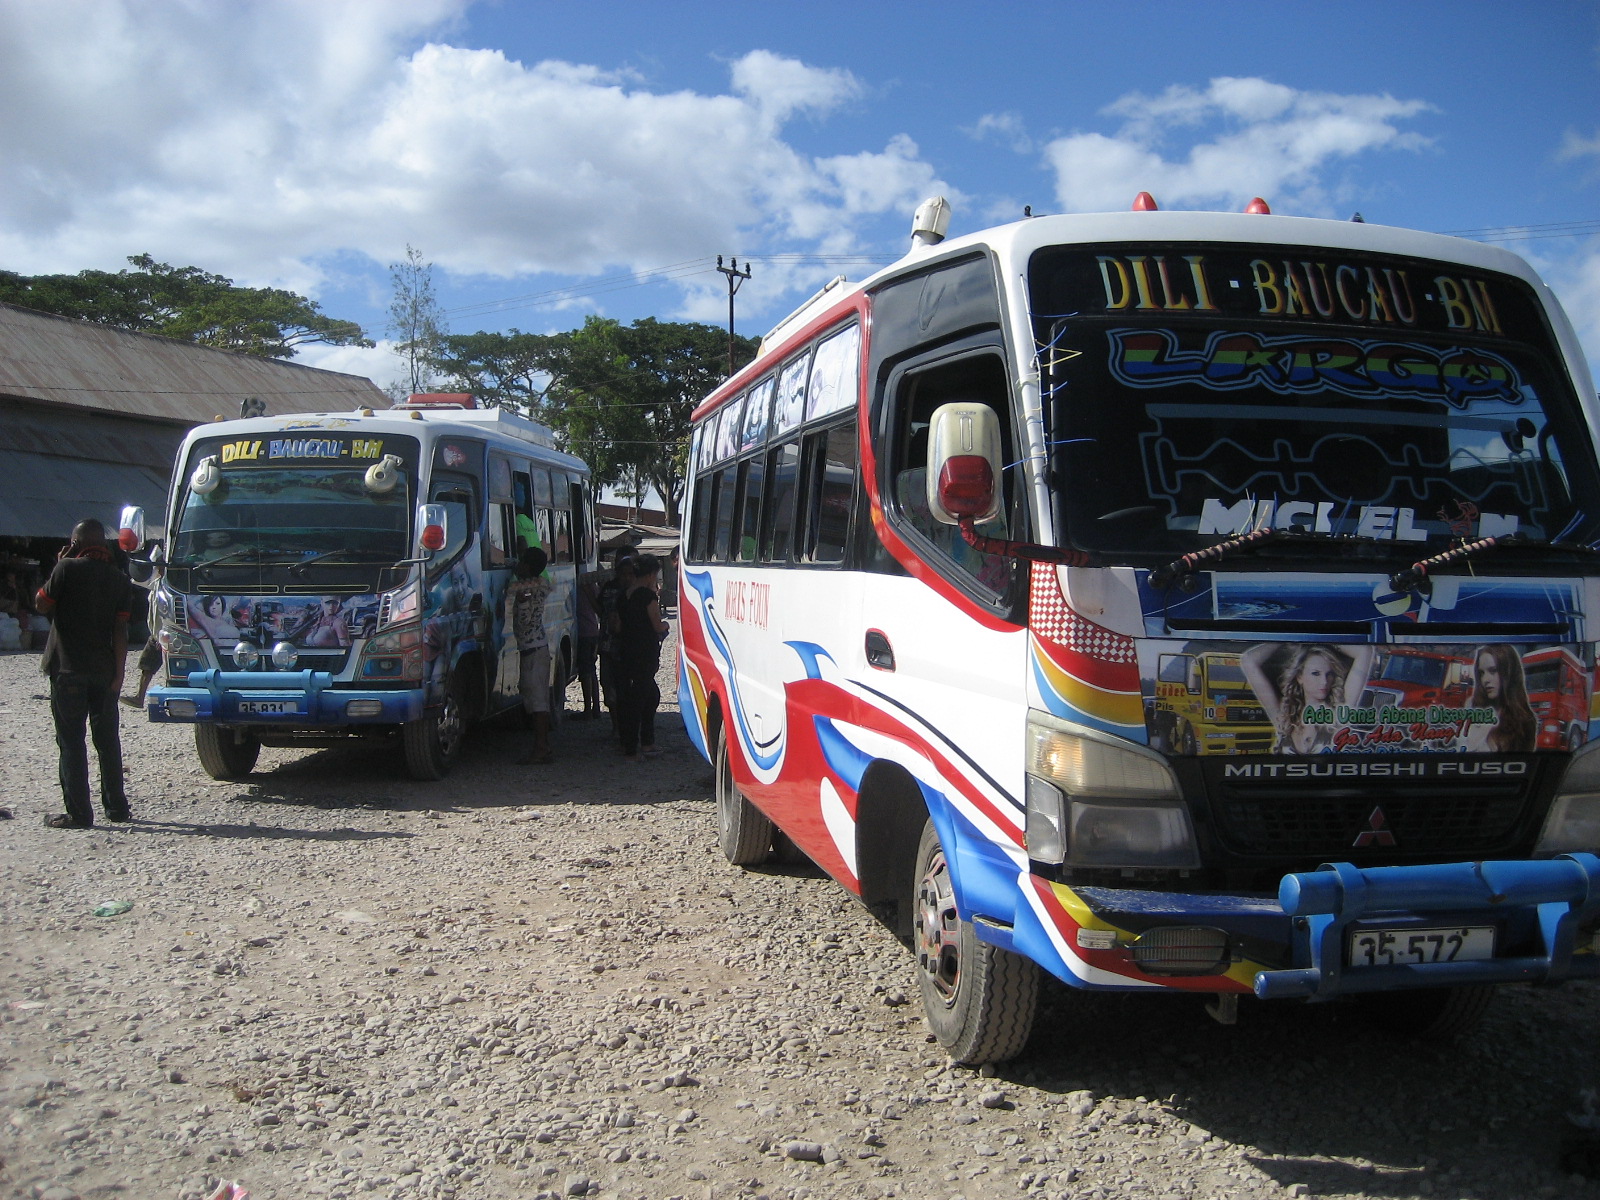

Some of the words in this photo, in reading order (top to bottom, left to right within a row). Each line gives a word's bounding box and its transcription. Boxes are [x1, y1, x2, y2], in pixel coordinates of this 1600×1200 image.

[1095, 255, 1219, 312] DILI
[1249, 259, 1417, 325] BAUCAU
[1434, 275, 1504, 335] BM
[1106, 328, 1523, 408] LARGO
[222, 440, 262, 463] DILI
[351, 439, 384, 459] BM
[1155, 702, 1174, 711] Pils
[1204, 707, 1215, 718] 10
[1303, 705, 1333, 725] Ada
[1337, 705, 1376, 725] Uang
[1379, 706, 1426, 725] Abang
[1333, 726, 1360, 750] Ga
[1364, 725, 1404, 745] Ada
[1224, 763, 1425, 777] MITSUBISHI
[1437, 761, 1527, 776] FUSO
